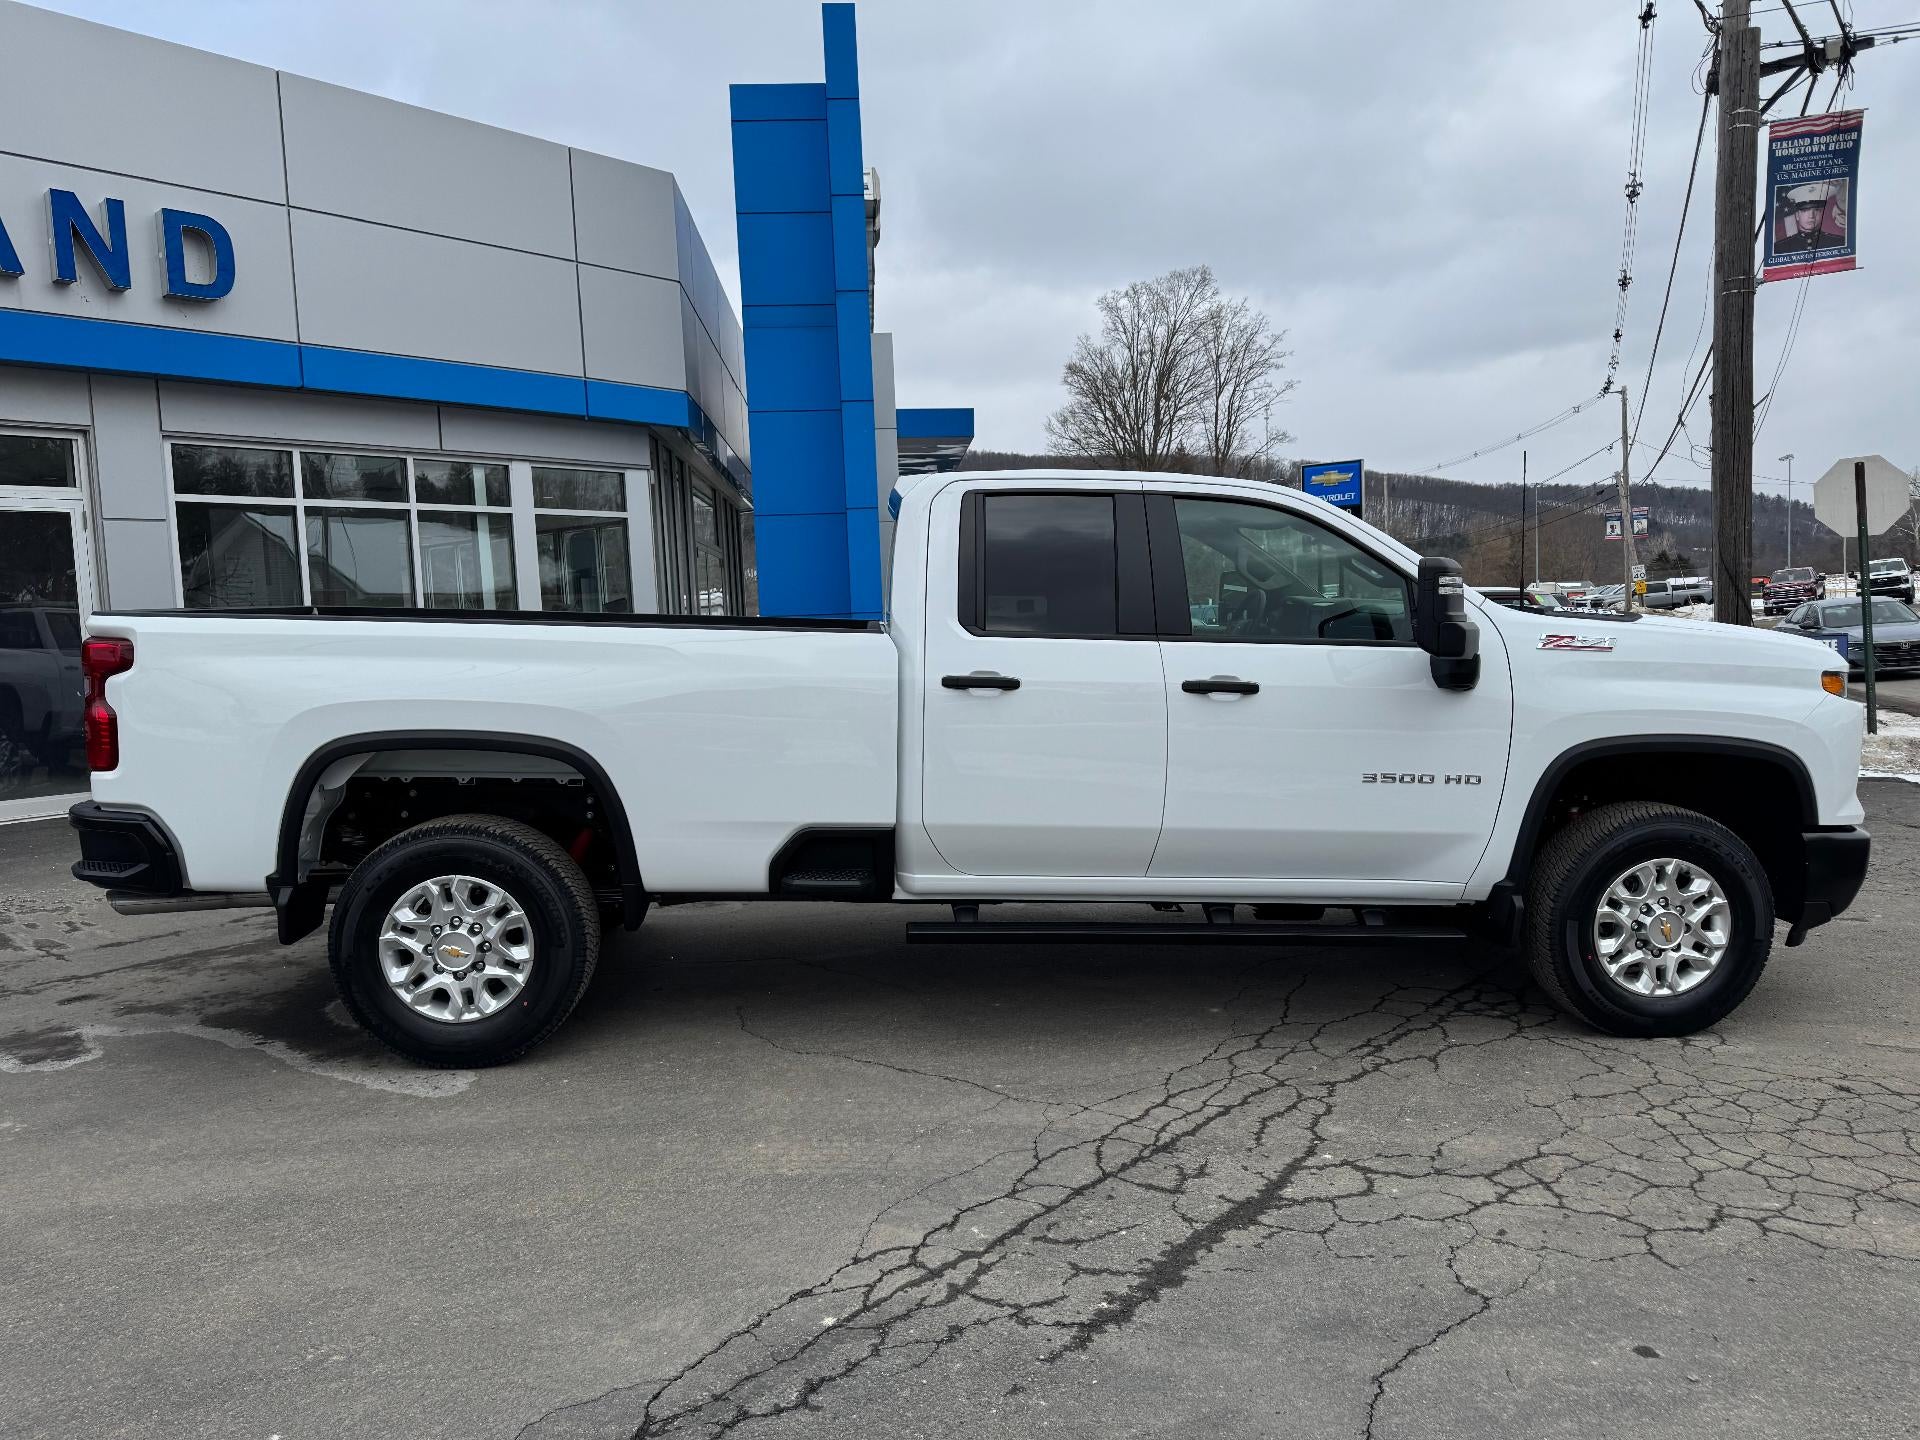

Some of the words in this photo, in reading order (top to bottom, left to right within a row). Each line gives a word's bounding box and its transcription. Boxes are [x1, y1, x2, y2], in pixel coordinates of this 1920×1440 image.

[1772, 138, 1811, 150] ELKLAND
[1813, 132, 1858, 145] BOROUGH
[1775, 144, 1826, 156] HOMETOWN
[1828, 141, 1854, 151] HERO
[1782, 161, 1817, 171] MICHAEL
[1818, 158, 1844, 167] PLANK
[1791, 170, 1822, 179] MARINE
[1823, 166, 1849, 175] CORPS
[1768, 256, 1791, 264] GLOBAL
[1361, 773, 1435, 784] 3500
[1444, 774, 1482, 785] HD
